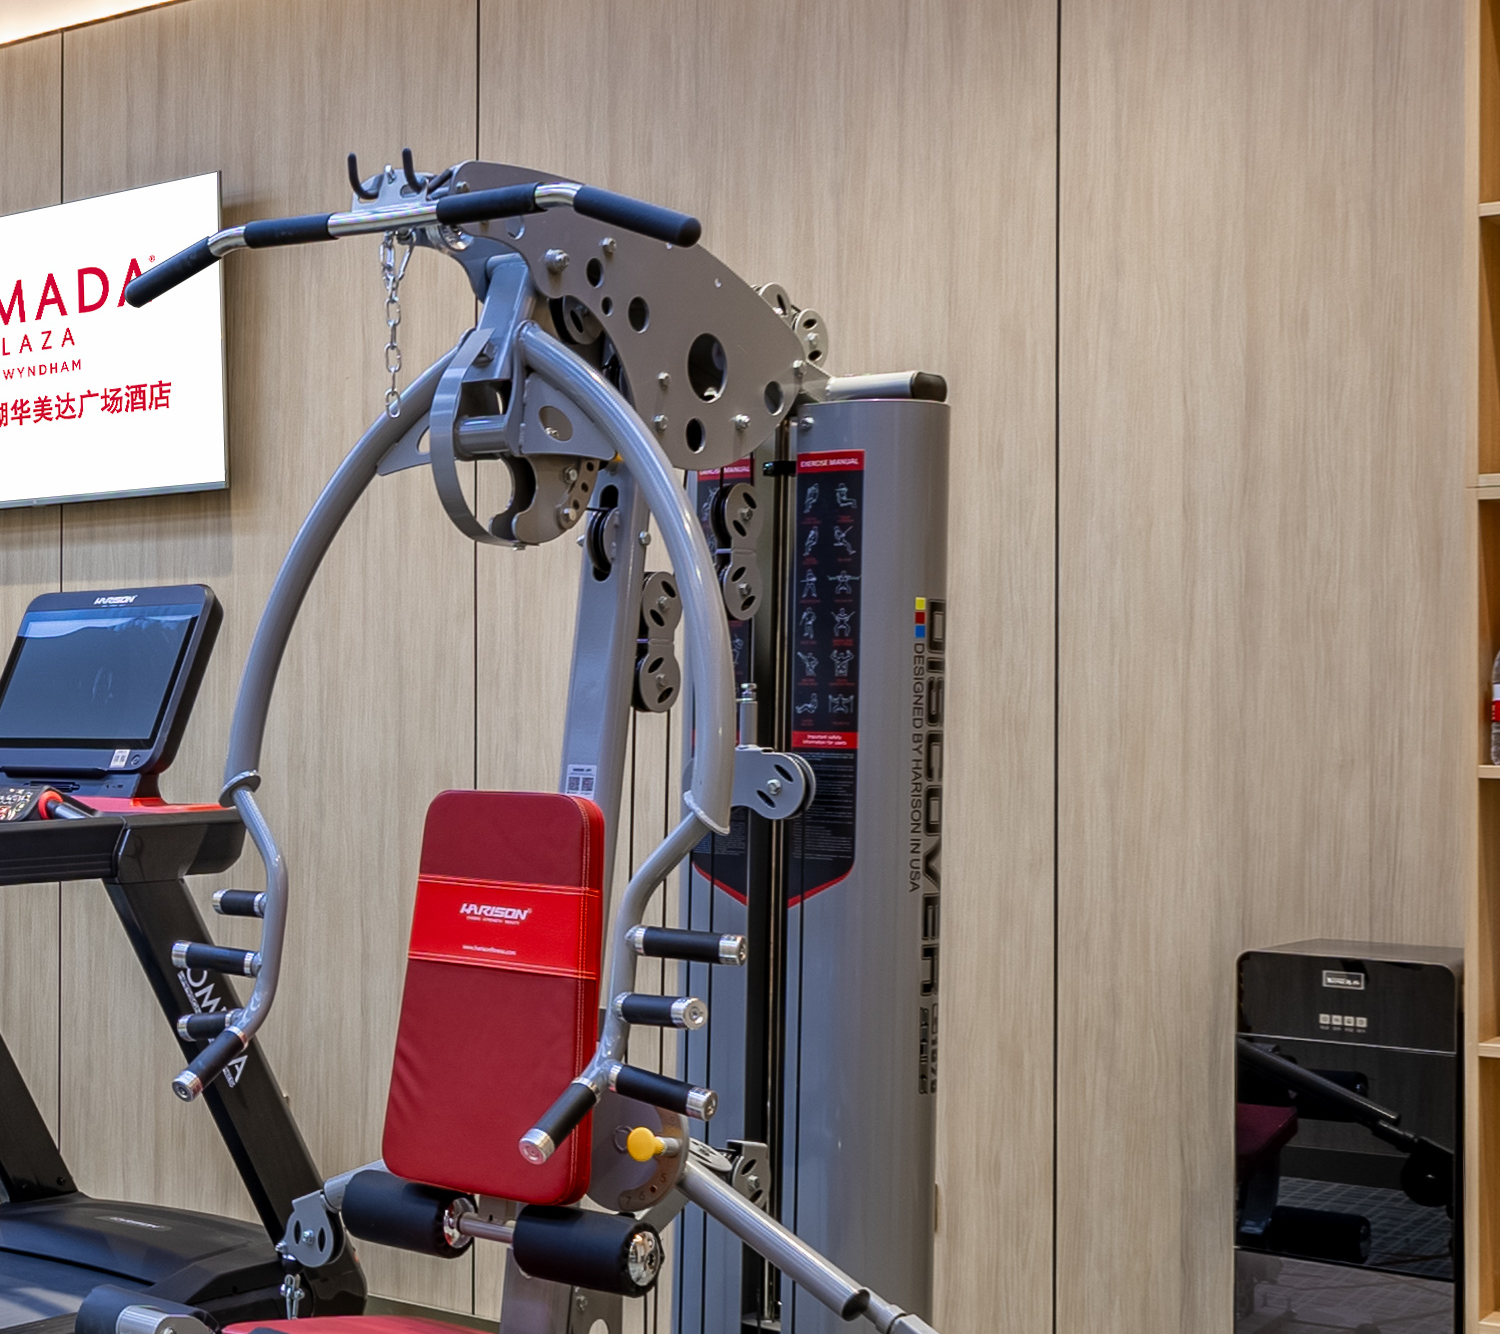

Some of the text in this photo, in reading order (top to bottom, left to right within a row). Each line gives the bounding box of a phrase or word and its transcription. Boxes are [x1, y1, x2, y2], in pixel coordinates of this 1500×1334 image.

[2, 358, 82, 381] WYNDHAM
[908, 642, 926, 893] DESIGNED BY HARISON IN USA
[459, 902, 529, 921] HARISON
